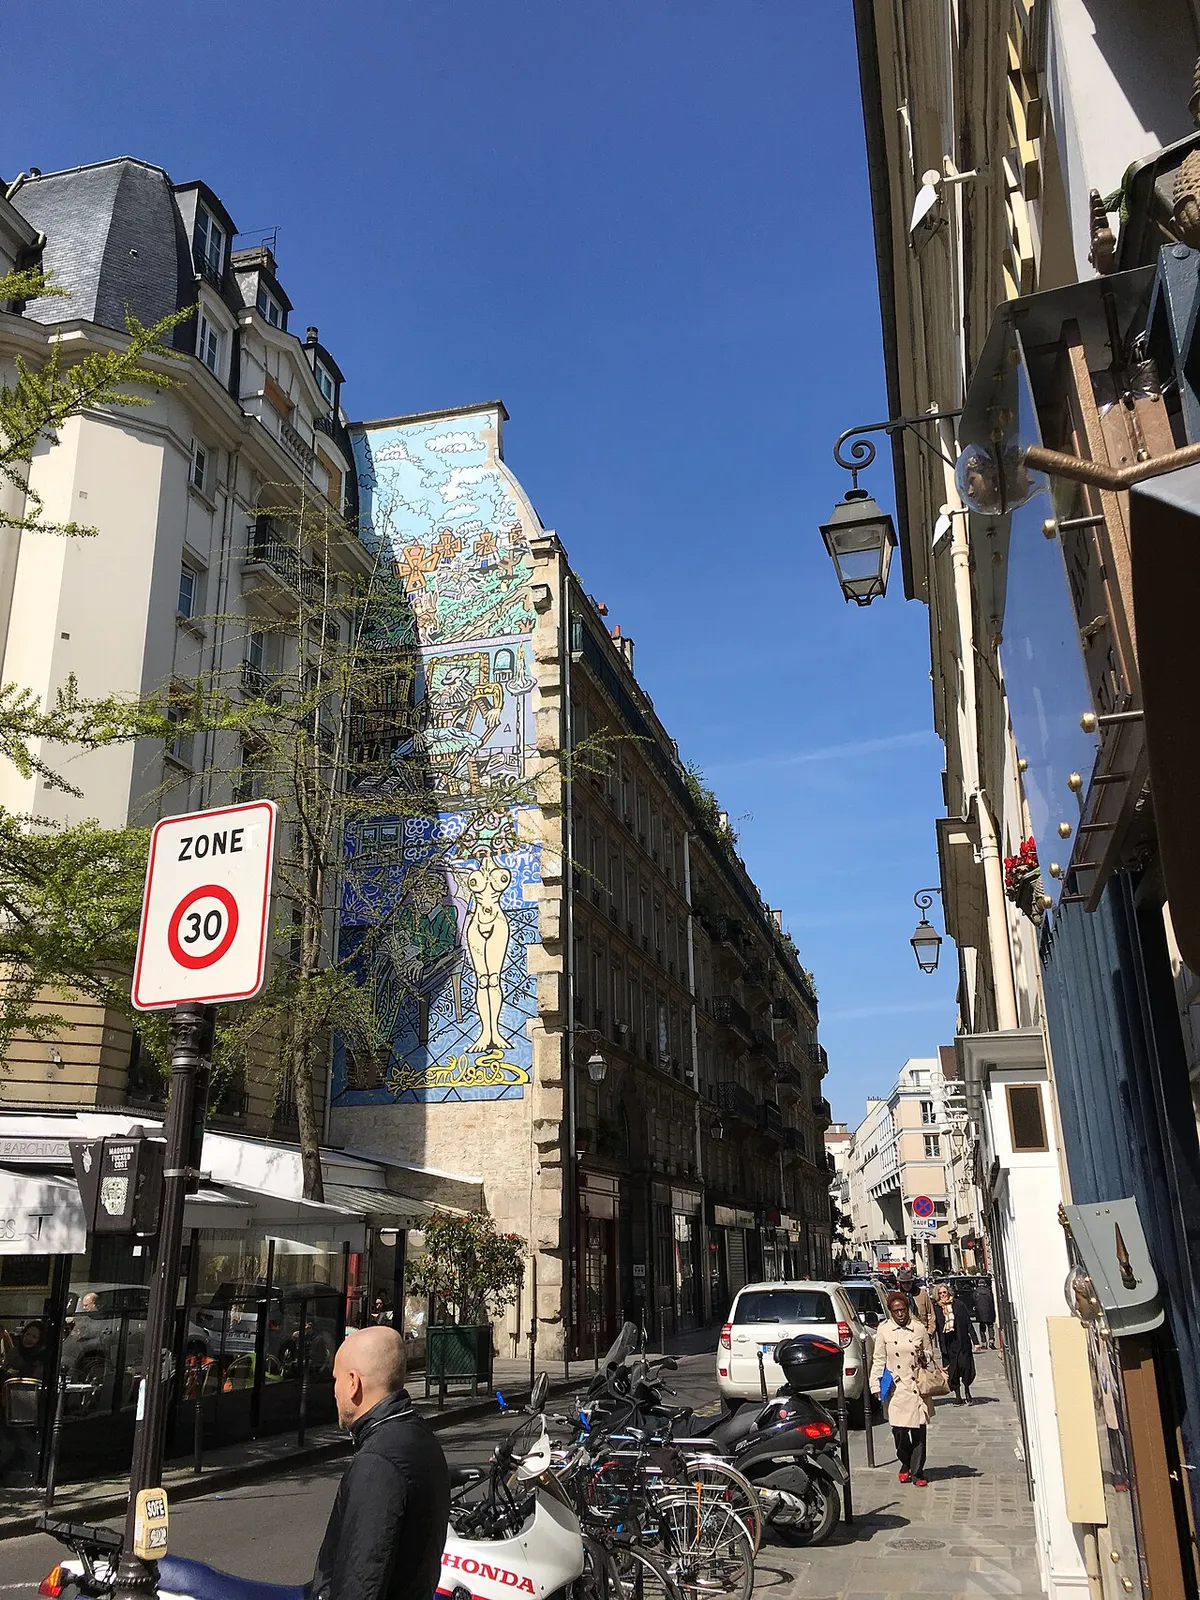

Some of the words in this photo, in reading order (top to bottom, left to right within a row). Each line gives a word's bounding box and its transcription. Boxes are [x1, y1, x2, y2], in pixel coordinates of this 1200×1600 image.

[178, 828, 244, 861] ZONE
[184, 910, 222, 943] 30
[108, 1146, 134, 1155] MADONNA
[147, 1499, 165, 1518] SOFE
[441, 1553, 535, 1595] HONDA
